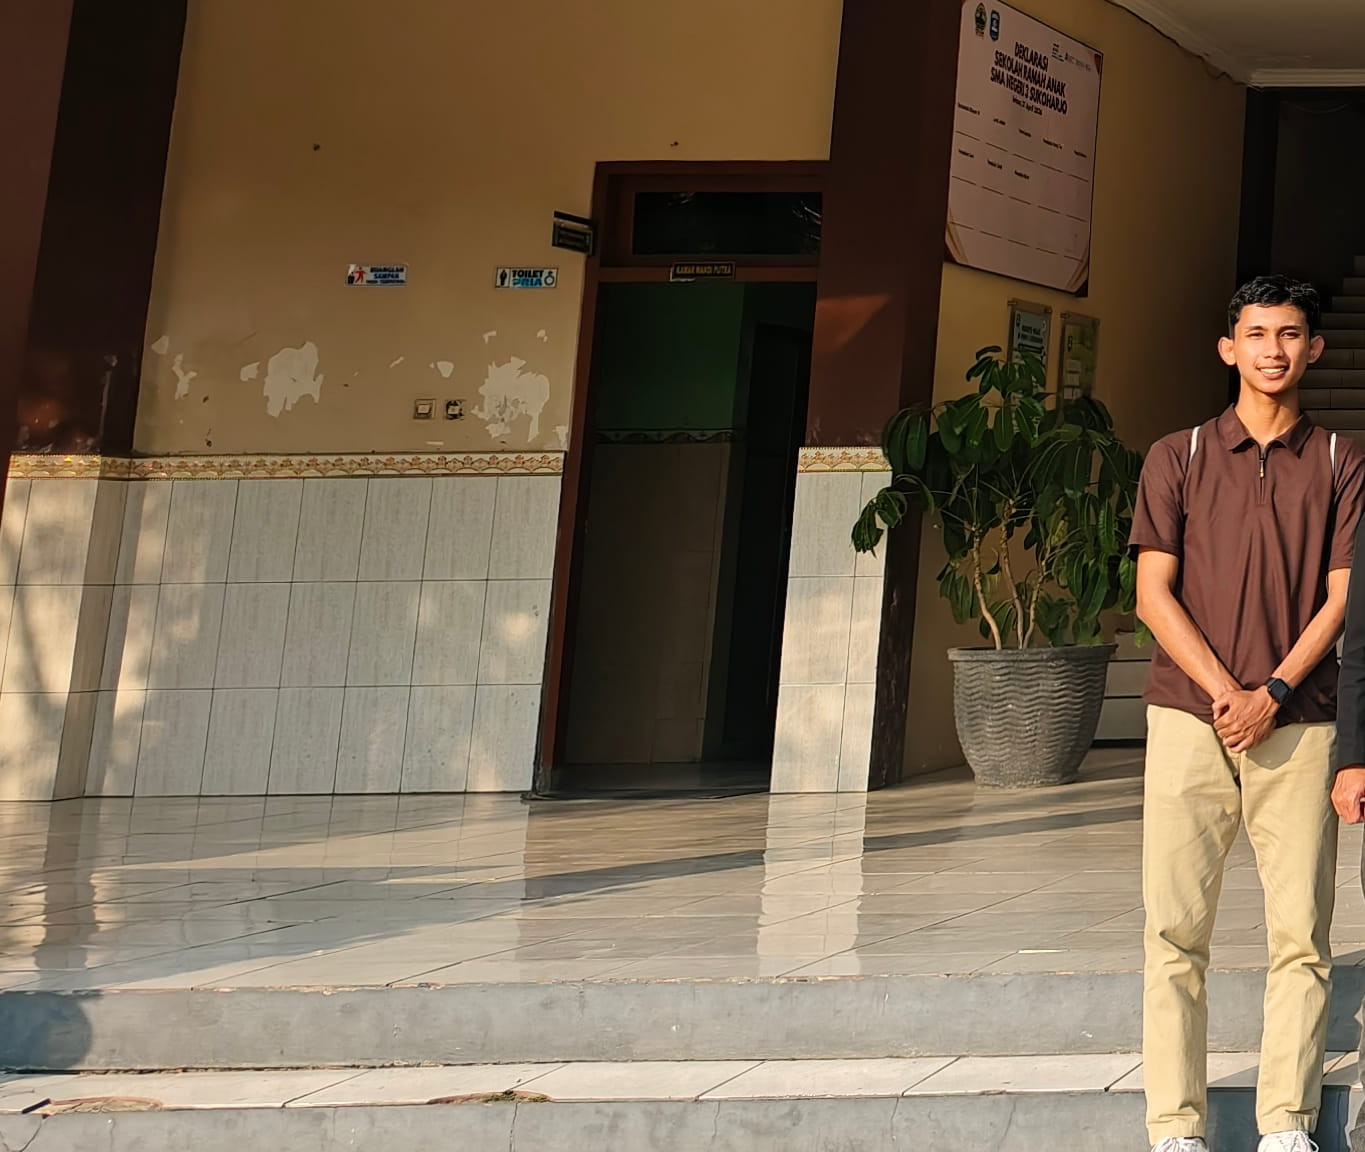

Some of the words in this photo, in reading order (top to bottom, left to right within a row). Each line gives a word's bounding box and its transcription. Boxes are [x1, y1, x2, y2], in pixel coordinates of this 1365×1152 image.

[993, 49, 1023, 79] SEKOLAH
[1022, 63, 1046, 91] RAMAH
[1045, 76, 1067, 99] ANAK
[1014, 41, 1049, 73] DEKLARASI
[990, 66, 1006, 89] SMA
[1005, 72, 1024, 97] NEGERI
[1029, 86, 1068, 116] SUKOHARJO
[511, 269, 545, 278] TOILET
